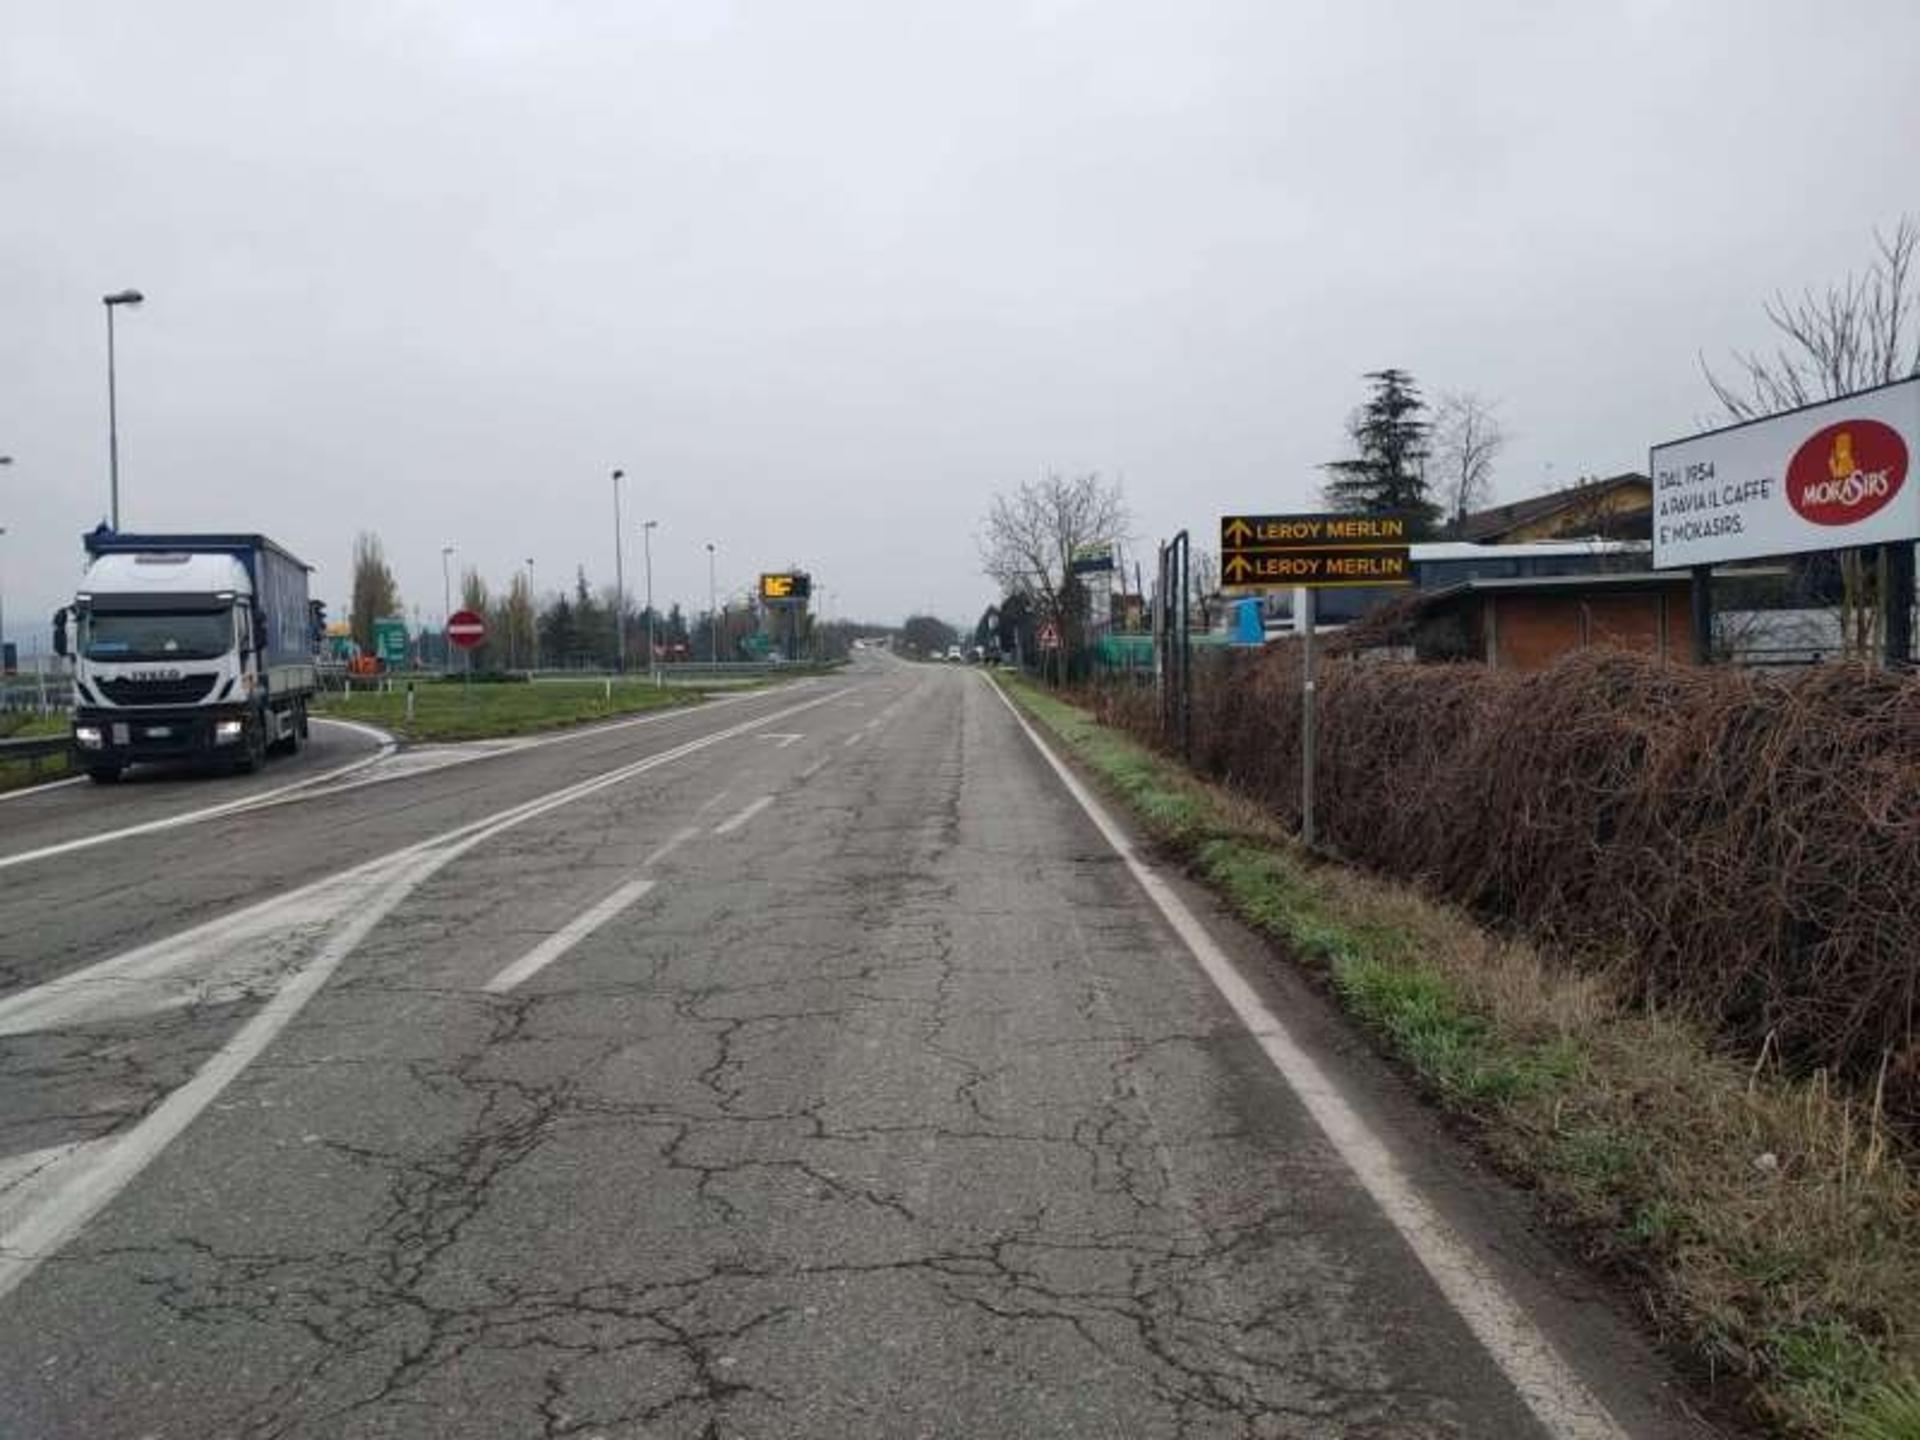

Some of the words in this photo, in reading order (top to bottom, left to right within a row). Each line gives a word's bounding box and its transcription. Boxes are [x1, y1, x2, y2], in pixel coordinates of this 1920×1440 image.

[1659, 471, 1683, 491] DAL
[1685, 460, 1715, 486] 1954
[1660, 501, 1669, 517] A
[1670, 492, 1707, 515] PAVIA
[1708, 489, 1722, 510] IL
[1256, 523, 1321, 540] LEROY
[1326, 521, 1403, 538] MERLIN
[1256, 558, 1320, 575] LEROY
[1326, 557, 1403, 575] MERLIN
